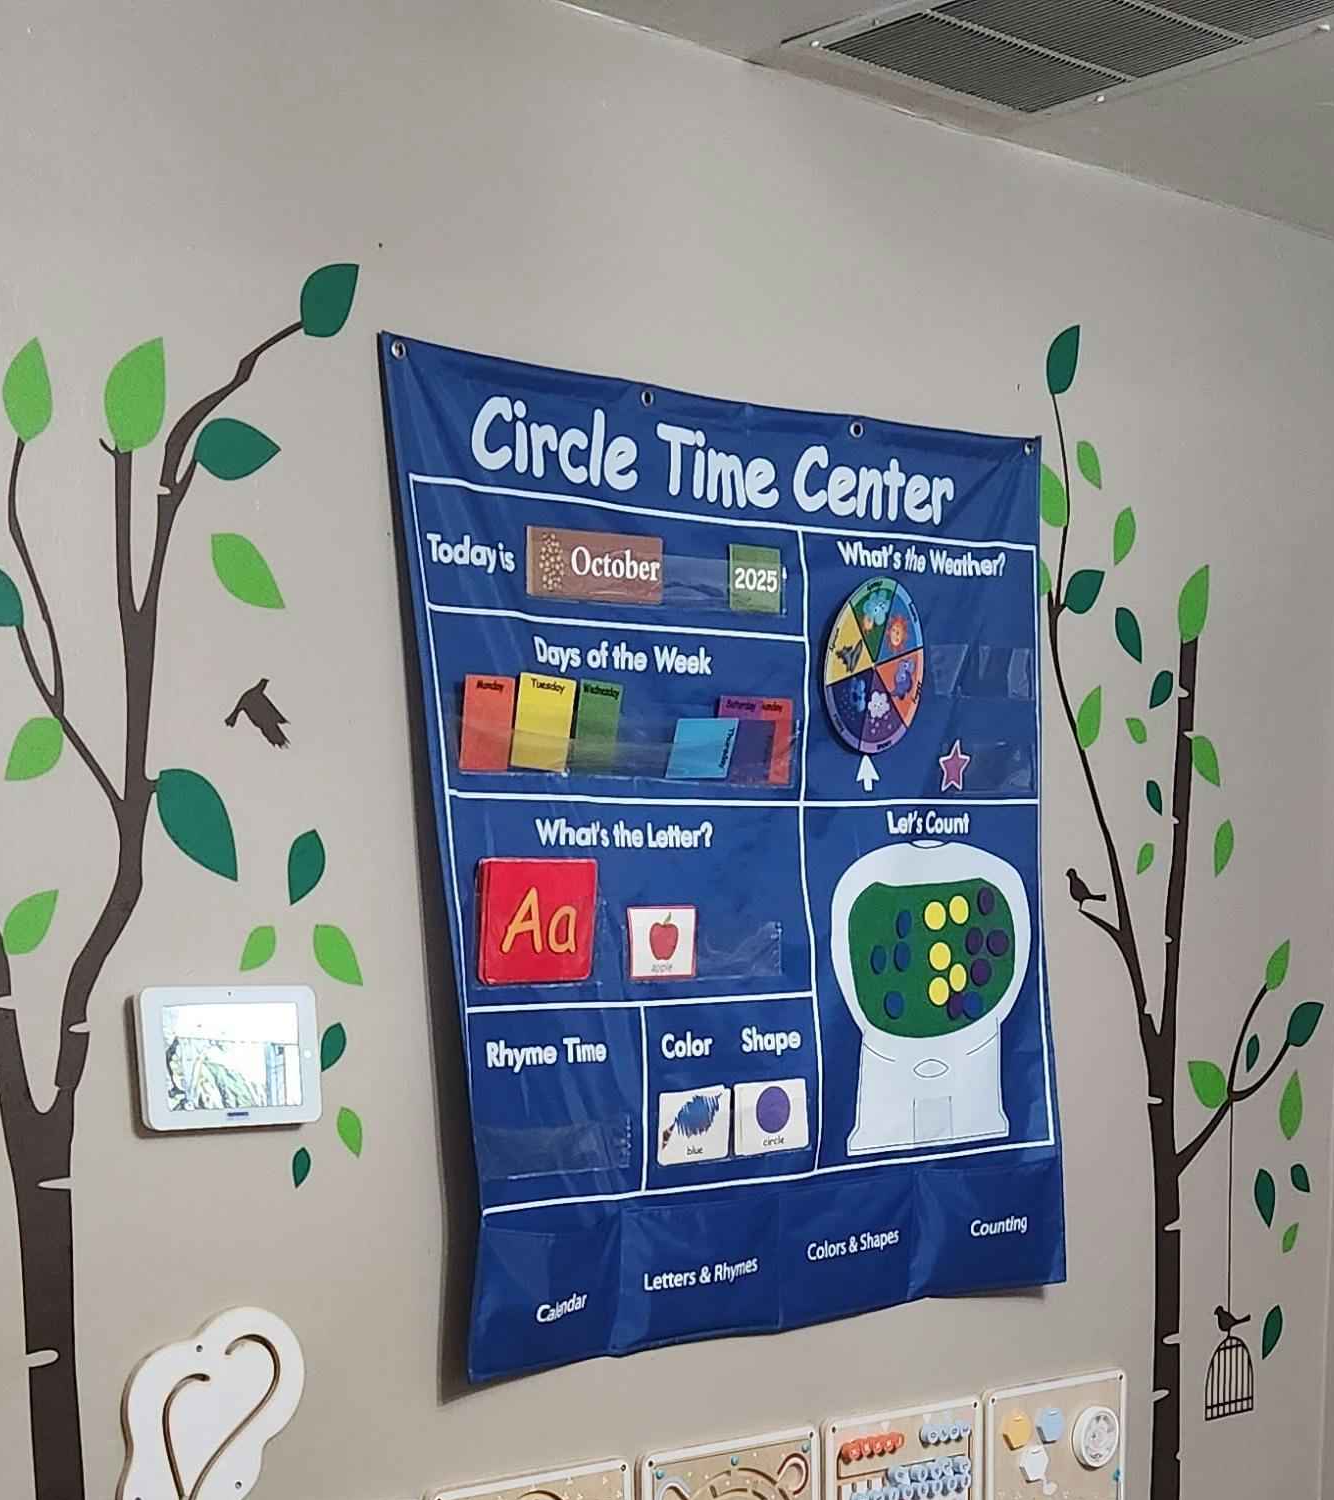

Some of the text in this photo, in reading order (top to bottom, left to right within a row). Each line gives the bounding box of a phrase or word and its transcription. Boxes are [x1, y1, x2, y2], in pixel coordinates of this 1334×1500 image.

[471, 395, 955, 526] Circle Time Center
[427, 532, 515, 575] Today is
[571, 545, 661, 582] October
[837, 541, 1006, 579] What's the Weather?
[734, 567, 778, 593] 2025
[535, 636, 712, 676] Days of the Week
[476, 679, 504, 694] Monday
[530, 678, 566, 695] Tuesday
[581, 681, 621, 701] Wednesday
[726, 698, 757, 714] Saturday
[718, 725, 735, 771] Thursday
[536, 819, 712, 848] What's the Letter?
[887, 811, 970, 836] Let's Count
[501, 886, 578, 955] Aa
[651, 961, 674, 975] apple
[486, 1038, 607, 1074] Rhyme Time
[661, 1031, 713, 1060] Color
[741, 1028, 801, 1057] Shape
[686, 1144, 704, 1156] blue
[762, 1135, 785, 1148] circle
[970, 1214, 1028, 1238] Counting
[807, 1229, 900, 1262] Colors & Shapes
[644, 1256, 759, 1291] Letters & Rhymes
[536, 1292, 588, 1324] Calendar
